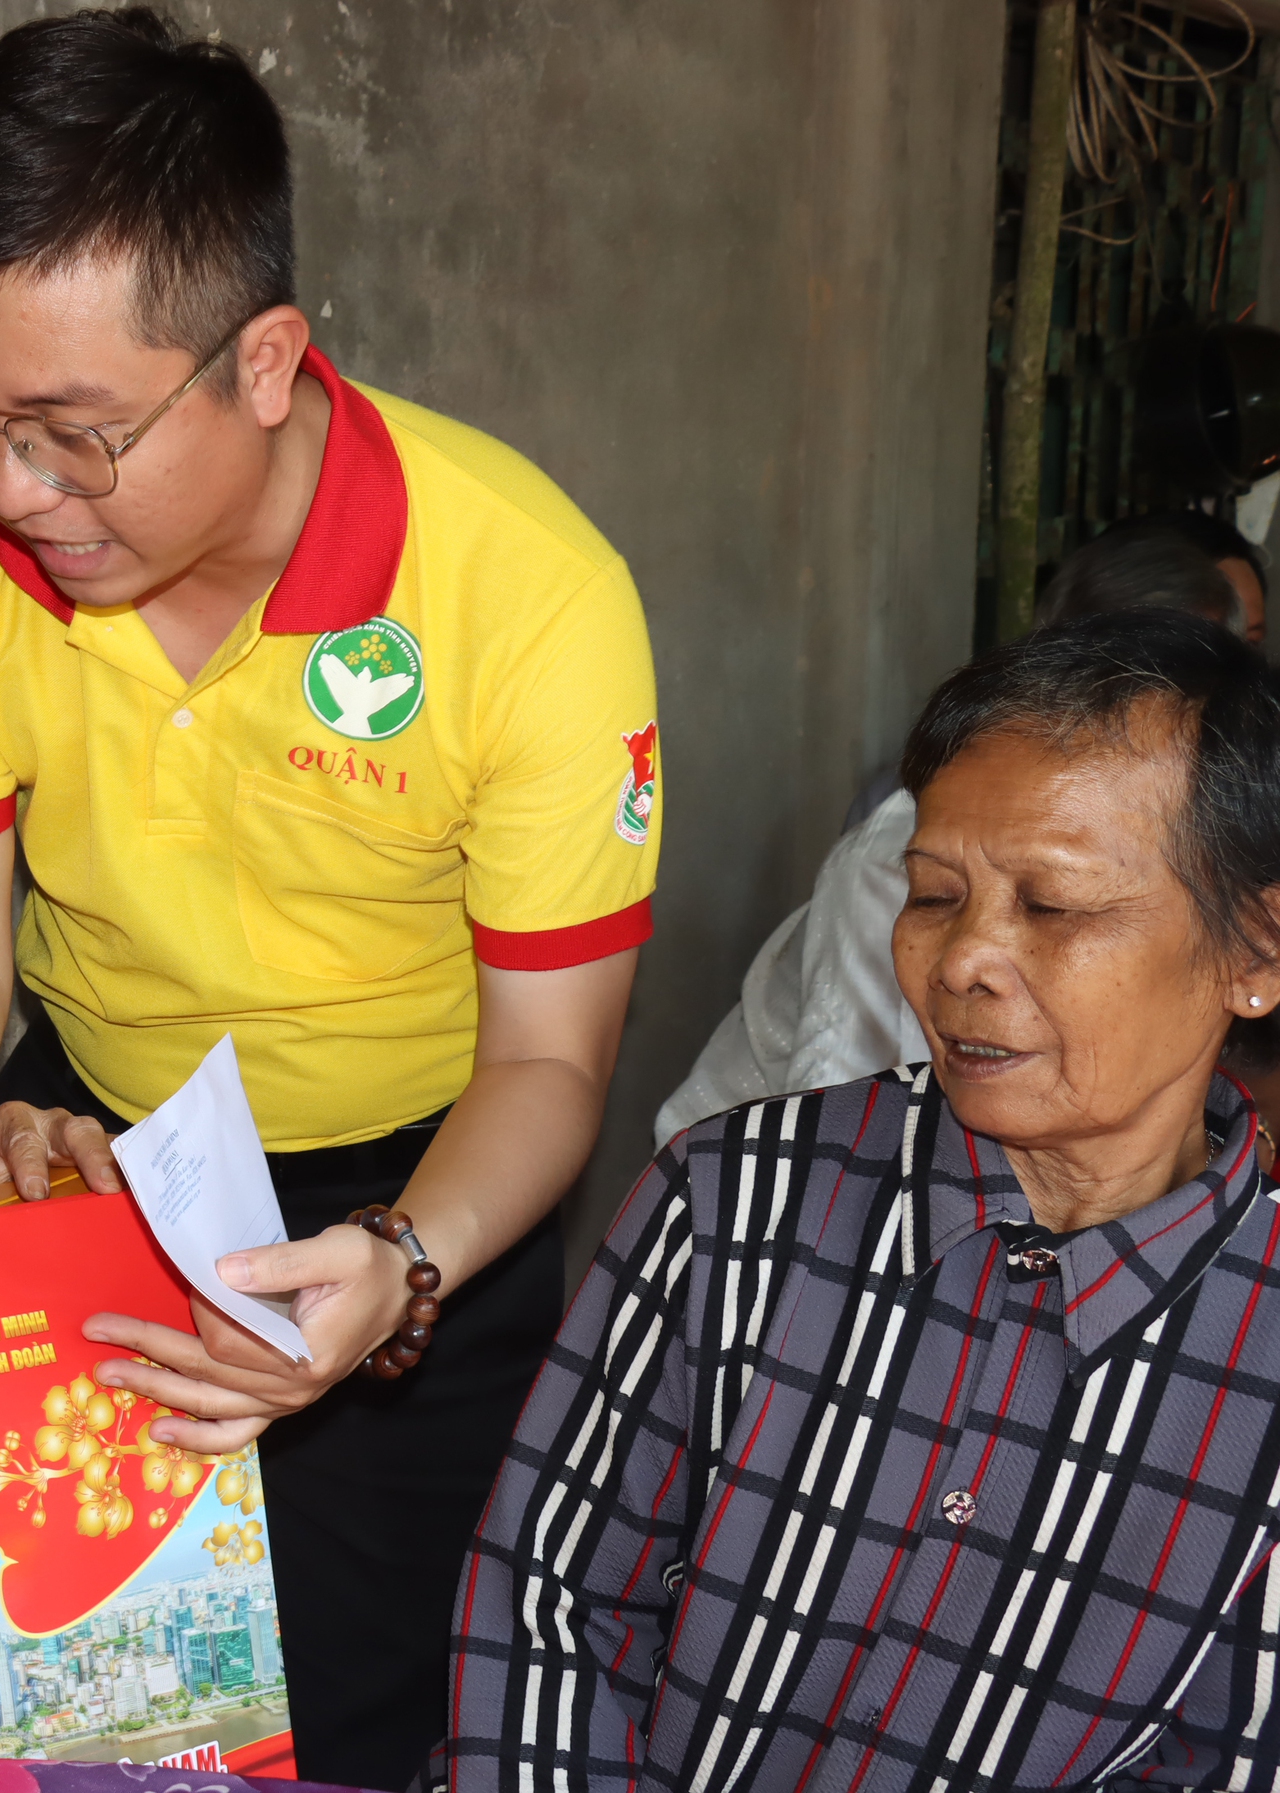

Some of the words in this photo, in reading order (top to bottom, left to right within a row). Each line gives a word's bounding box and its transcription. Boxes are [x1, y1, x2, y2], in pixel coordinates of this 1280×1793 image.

[288, 746, 386, 788] QUẬN
[395, 771, 409, 794] 1
[0, 1310, 50, 1339] MINH
[9, 1341, 58, 1371] ĐOÀN
